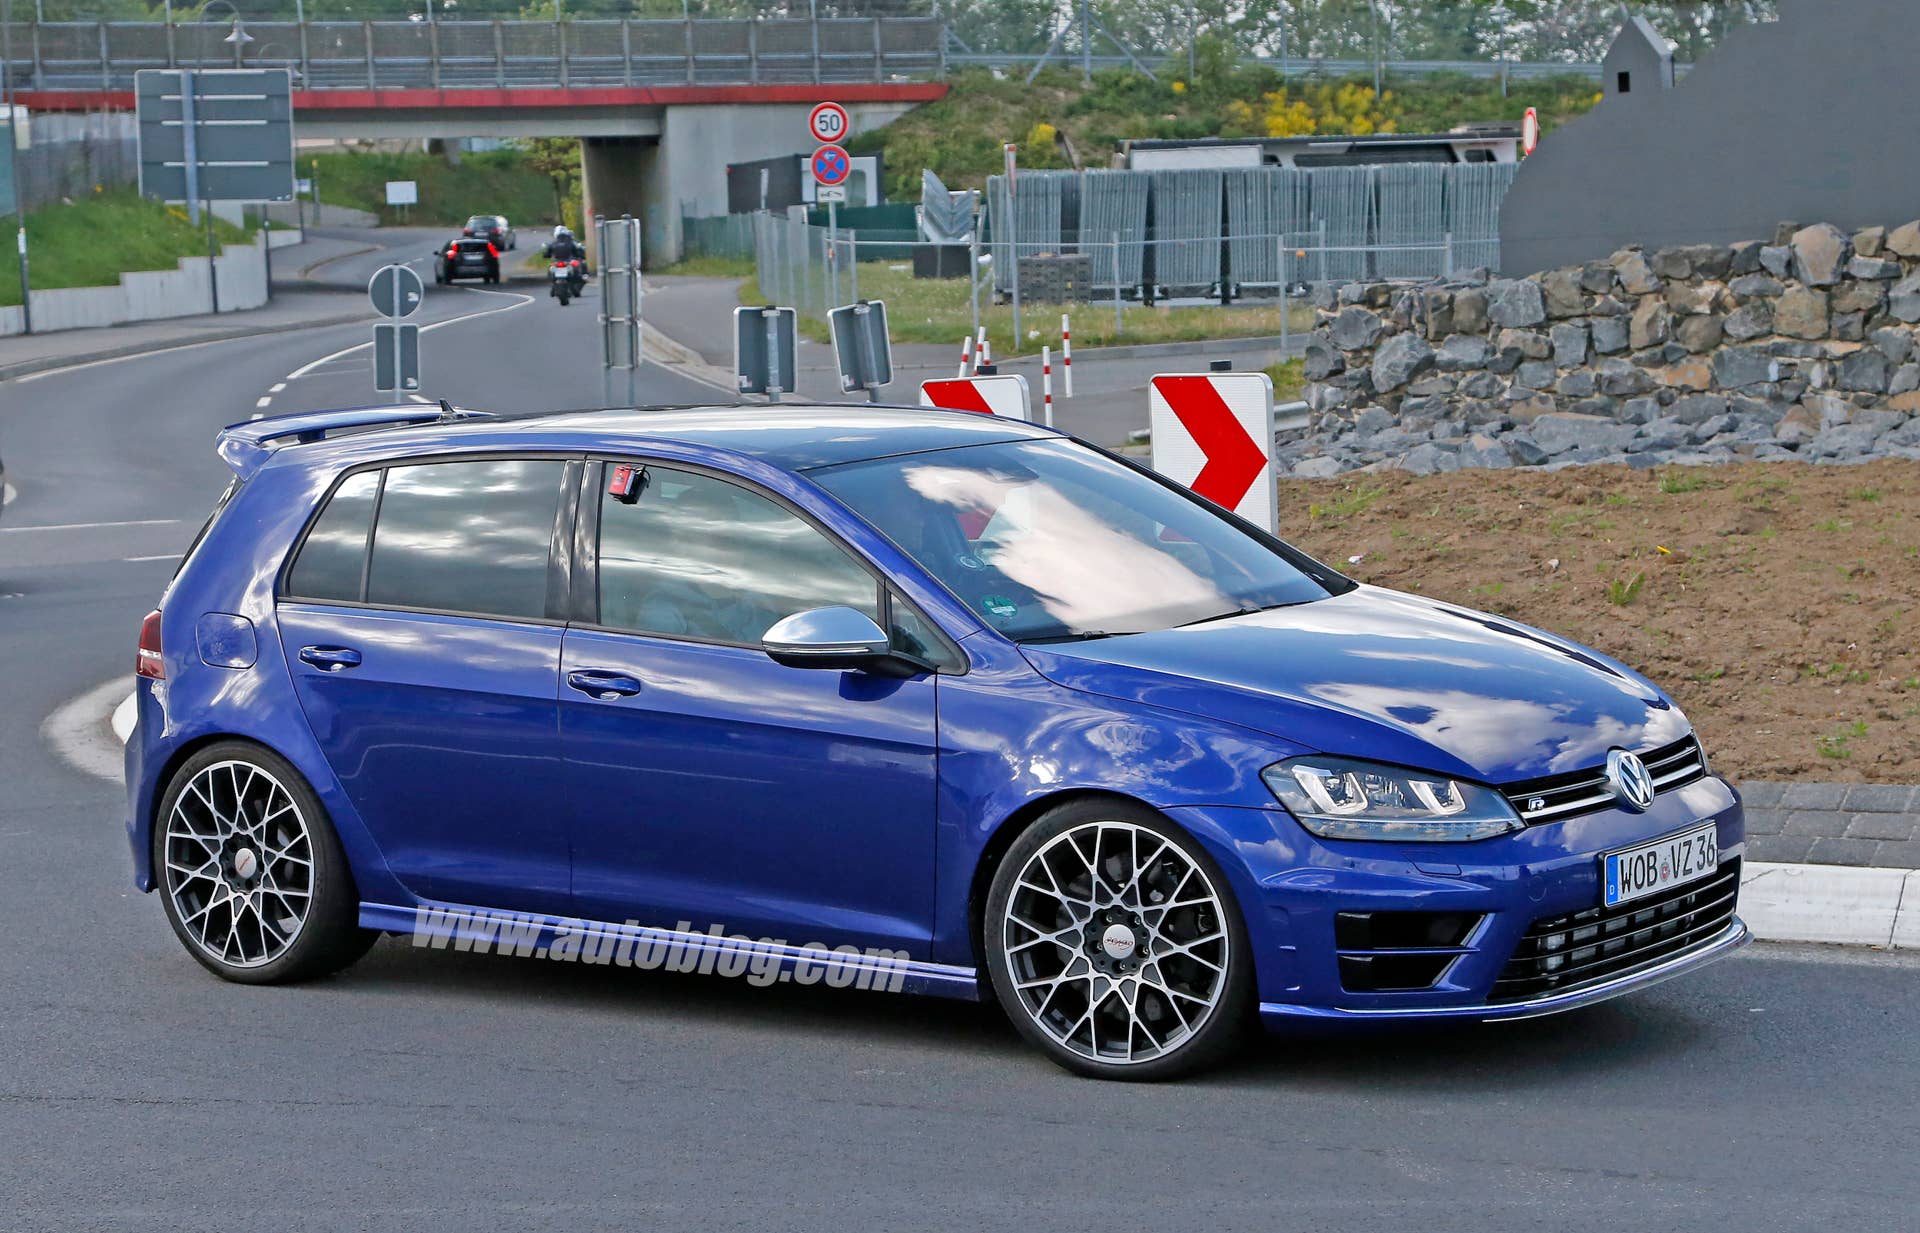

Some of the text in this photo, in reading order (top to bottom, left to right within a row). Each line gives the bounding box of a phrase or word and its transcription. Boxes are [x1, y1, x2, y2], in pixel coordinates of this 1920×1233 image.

[818, 114, 840, 132] 50
[1527, 796, 1545, 811] R
[1620, 832, 1715, 893] WOB VZ 36
[1609, 884, 1615, 896] D
